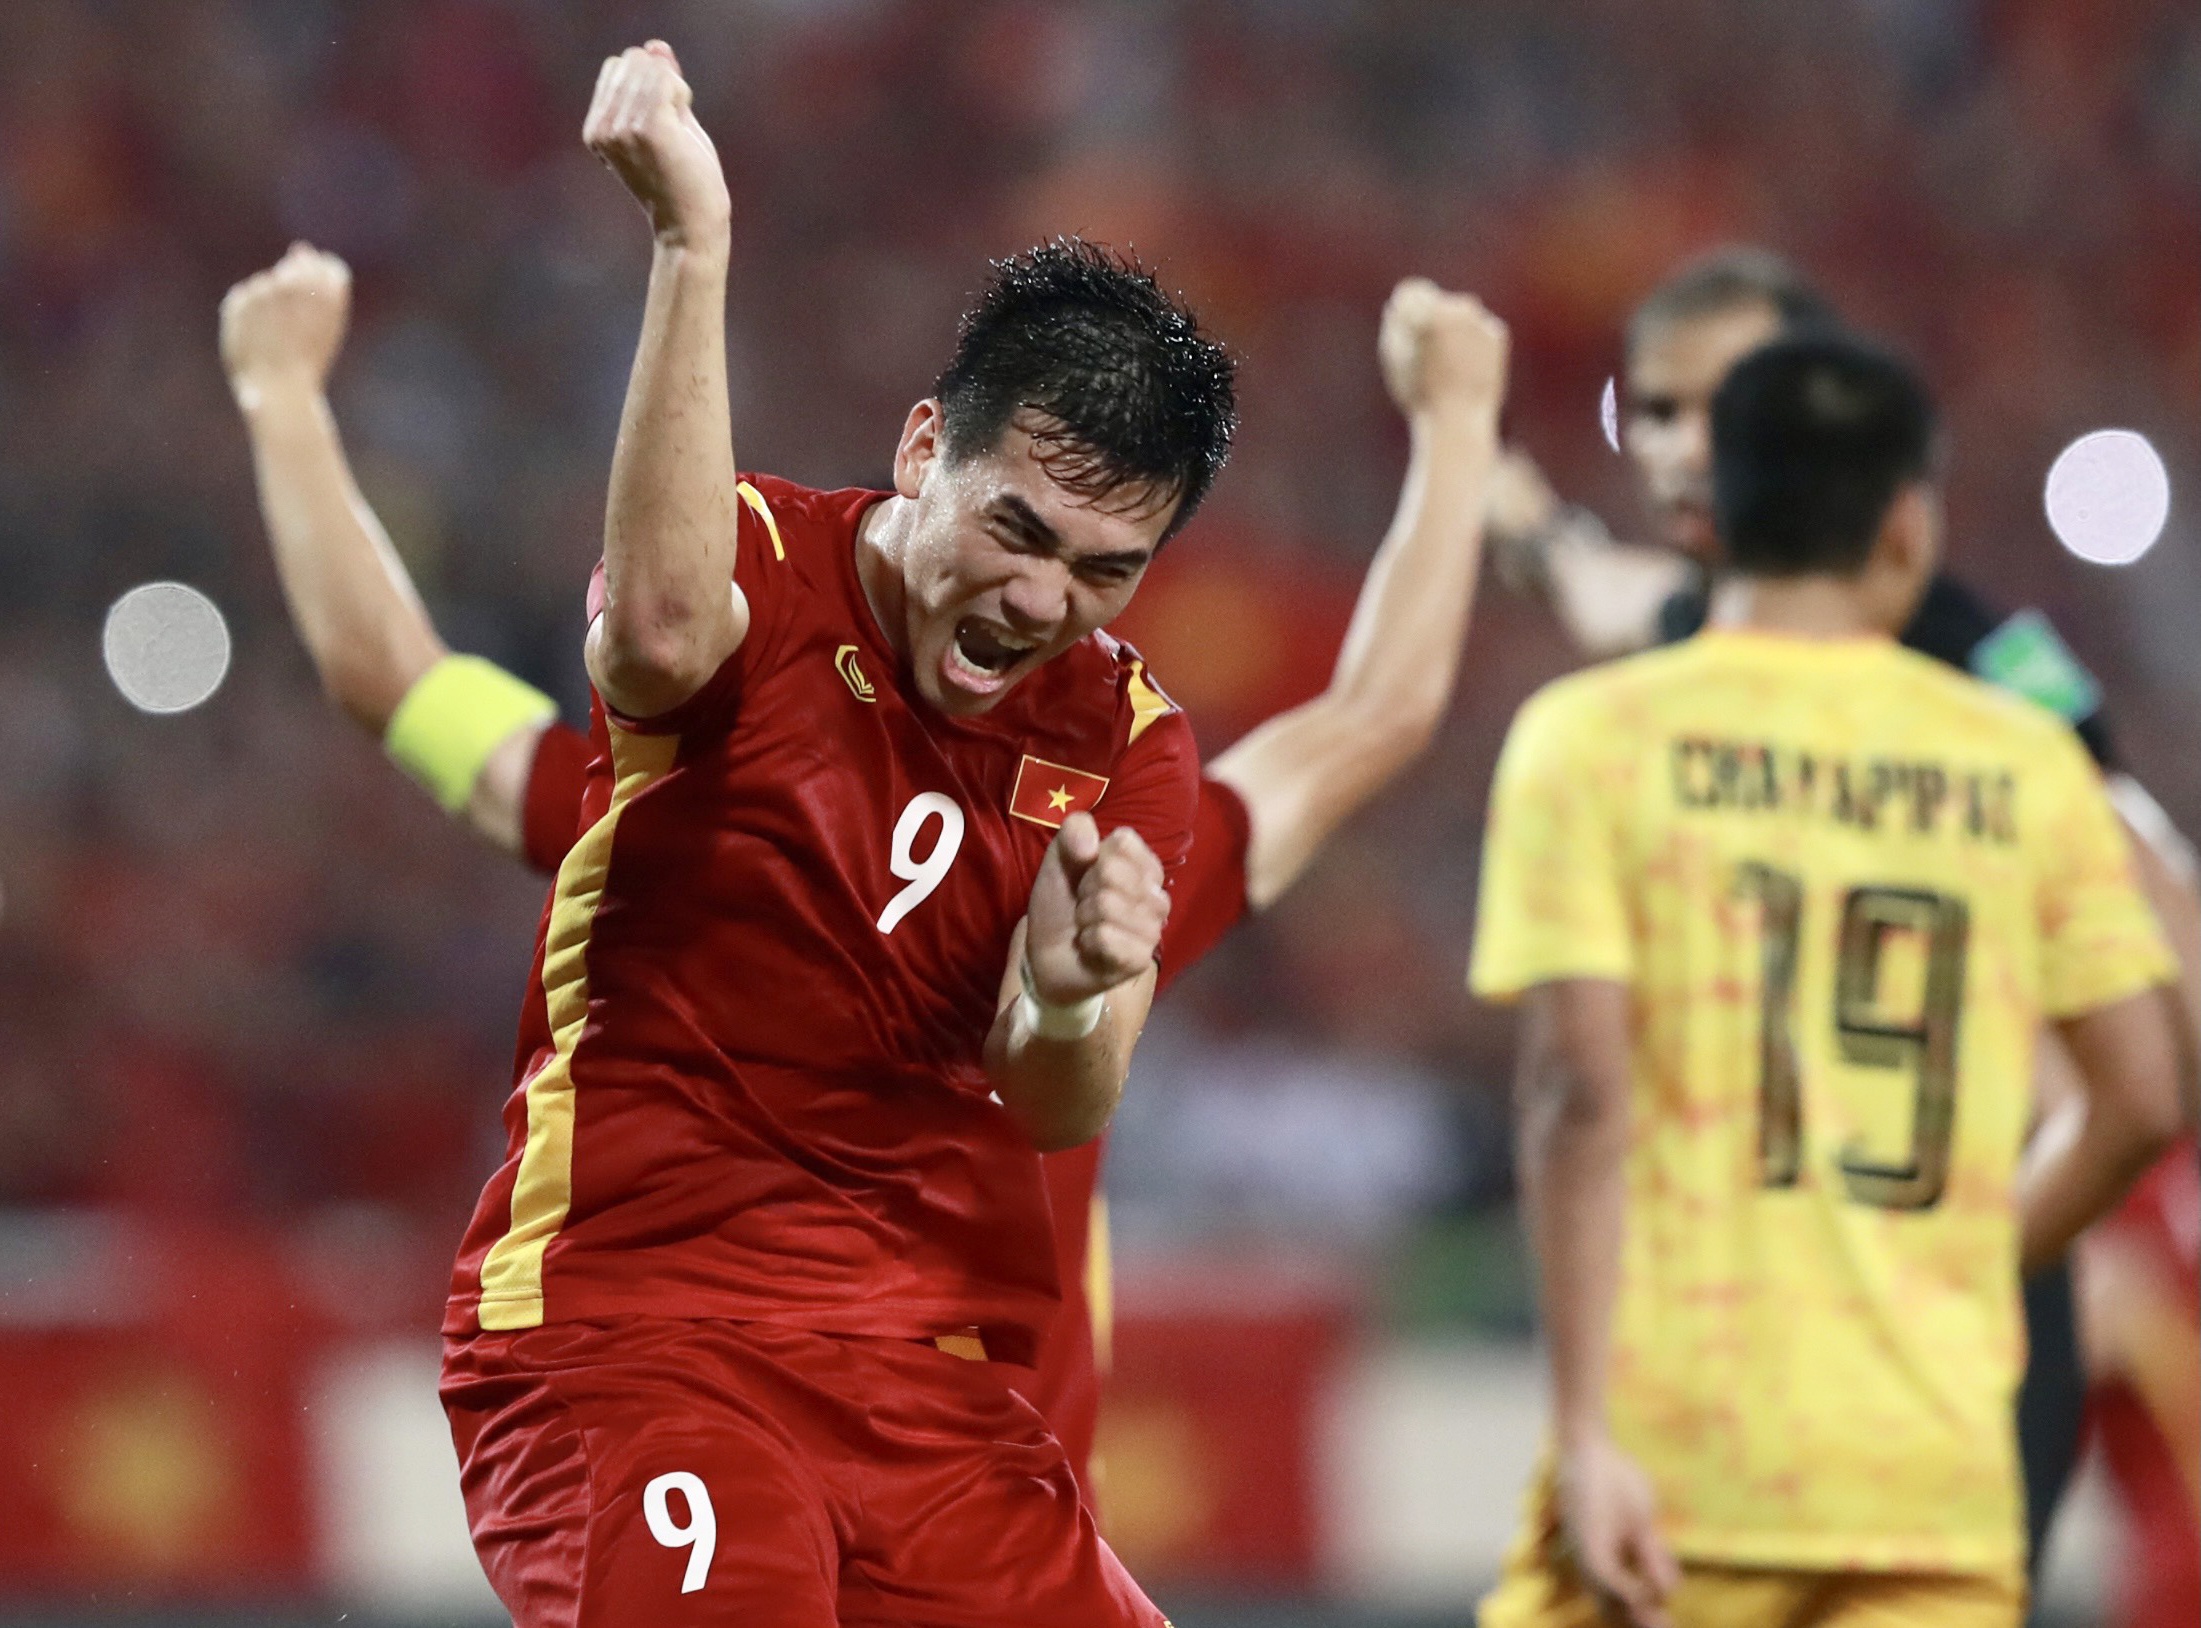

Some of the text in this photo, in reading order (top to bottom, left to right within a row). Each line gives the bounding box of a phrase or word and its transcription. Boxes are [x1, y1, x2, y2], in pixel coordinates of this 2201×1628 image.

[876, 791, 965, 935] 9
[1736, 862, 1969, 1212] 19
[643, 1471, 717, 1594] 9
